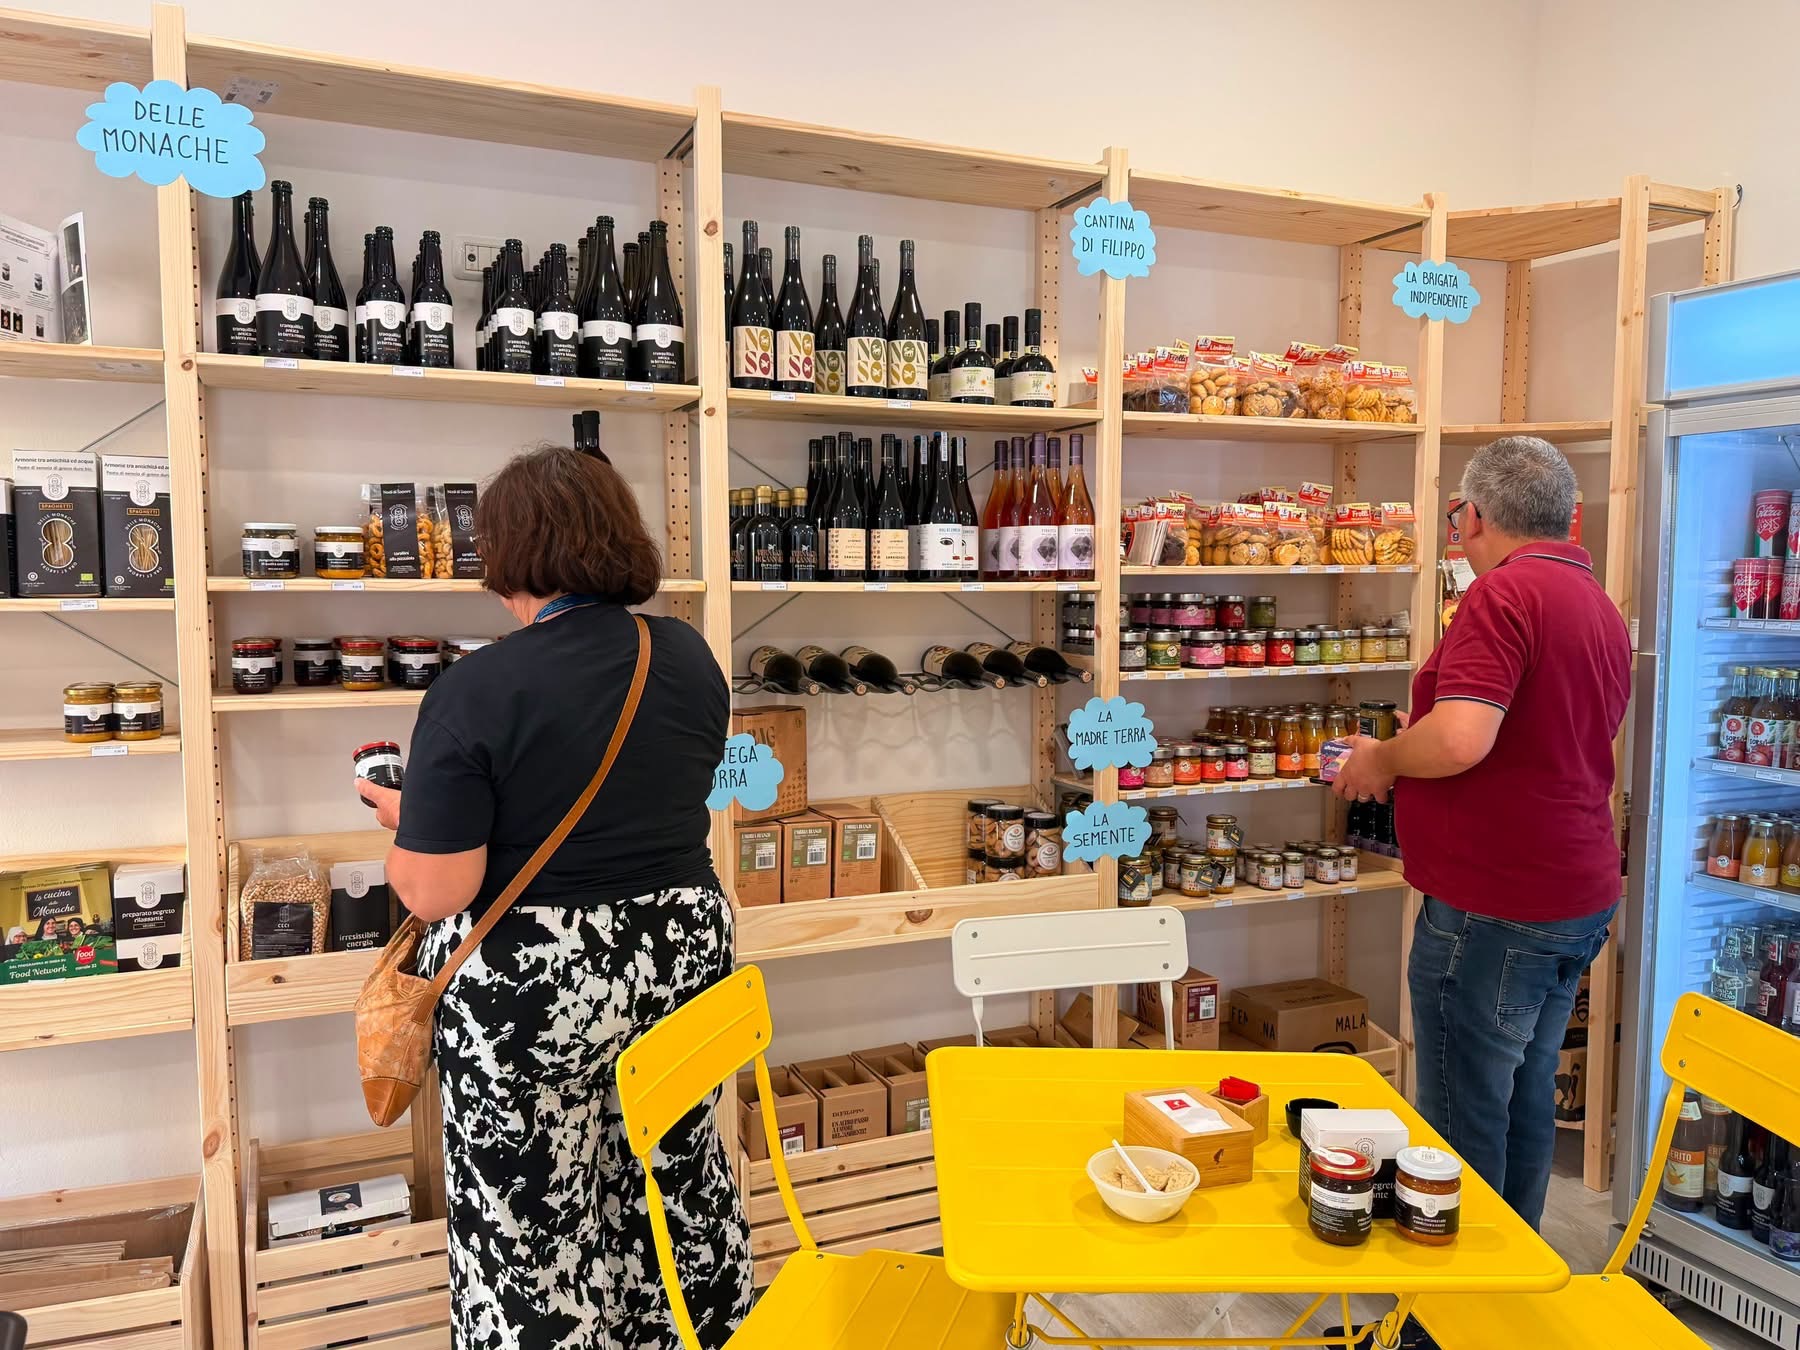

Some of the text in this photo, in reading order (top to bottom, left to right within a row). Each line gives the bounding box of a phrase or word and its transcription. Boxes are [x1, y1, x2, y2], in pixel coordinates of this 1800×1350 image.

[134, 100, 206, 129] DELLE
[103, 128, 230, 164] MONACHE
[1084, 214, 1135, 232] CANTINA
[1082, 237, 1145, 260] DI FILIPPO
[1406, 271, 1459, 288] LA BRIGATA
[1409, 290, 1469, 309] INDIPENDENTE
[745, 328, 774, 352] NO
[789, 332, 815, 356] NO
[1098, 711, 1113, 723] LA
[1076, 729, 1147, 746] MADRE TERRA
[1093, 813, 1109, 827] LA
[1073, 828, 1136, 849] SEMENTE
[43, 889, 73, 900] cucina
[33, 904, 76, 918] Monache
[121, 908, 176, 919] preparato segreto
[339, 931, 380, 942] irresistibile
[346, 939, 374, 948] energia
[76, 949, 95, 962] food
[9, 964, 68, 980] Food Network
[1335, 1012, 1368, 1033] MALA
[1669, 1151, 1693, 1163] ERITO
[1373, 1182, 1397, 1191] egret
